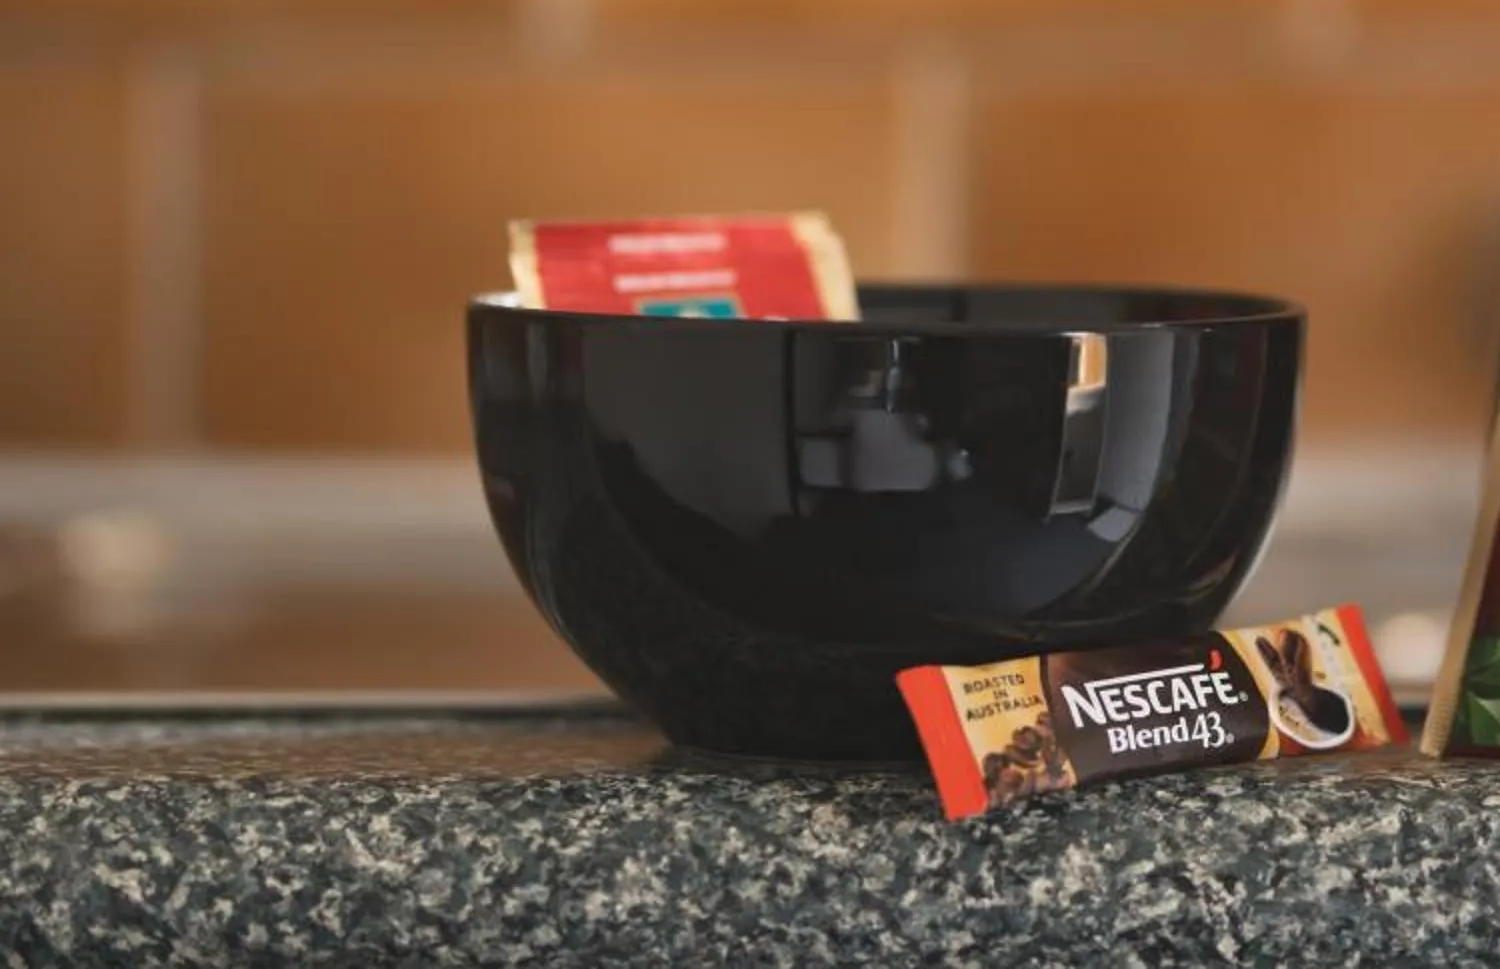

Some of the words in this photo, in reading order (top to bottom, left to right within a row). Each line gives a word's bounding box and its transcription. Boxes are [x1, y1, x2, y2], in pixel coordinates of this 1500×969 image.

[963, 673, 1025, 694] ROASTED
[993, 690, 1009, 700] IN
[965, 695, 1044, 721] AUSTRALIA
[1107, 716, 1189, 754] Blend
[1191, 711, 1226, 749] 43
